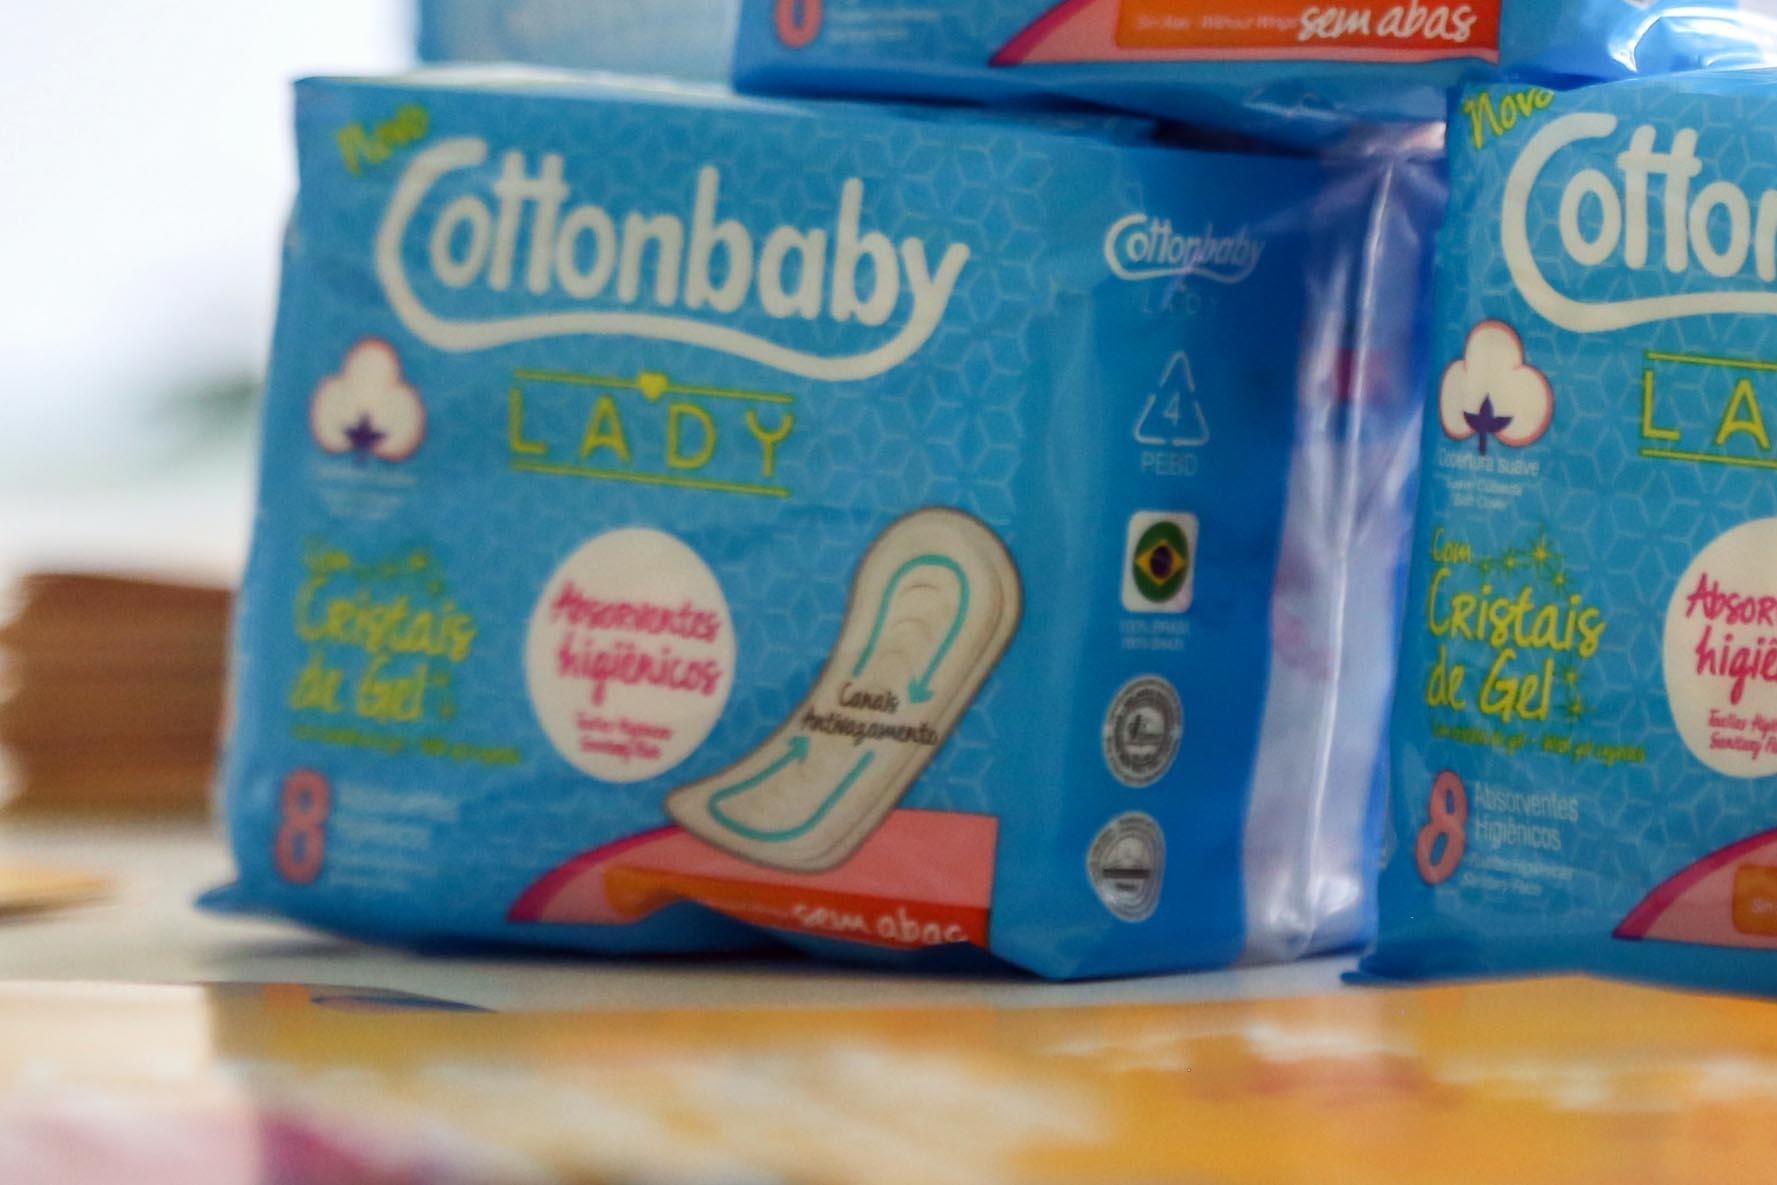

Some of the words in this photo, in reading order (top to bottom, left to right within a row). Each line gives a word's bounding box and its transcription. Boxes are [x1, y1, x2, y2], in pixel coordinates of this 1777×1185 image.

[1297, 4, 1372, 43] sem
[1463, 87, 1555, 149] Novo
[375, 136, 970, 383] Cottonbaby
[1104, 212, 1266, 284] Cottonbaby
[508, 387, 795, 478] LADY
[1428, 567, 1606, 659] Cristais
[839, 682, 899, 714] Canais
[1425, 647, 1466, 710] de
[1479, 648, 1554, 722] Gel
[275, 768, 331, 884] 8
[1416, 769, 1469, 886] 8
[1475, 782, 1579, 822] Absorventes
